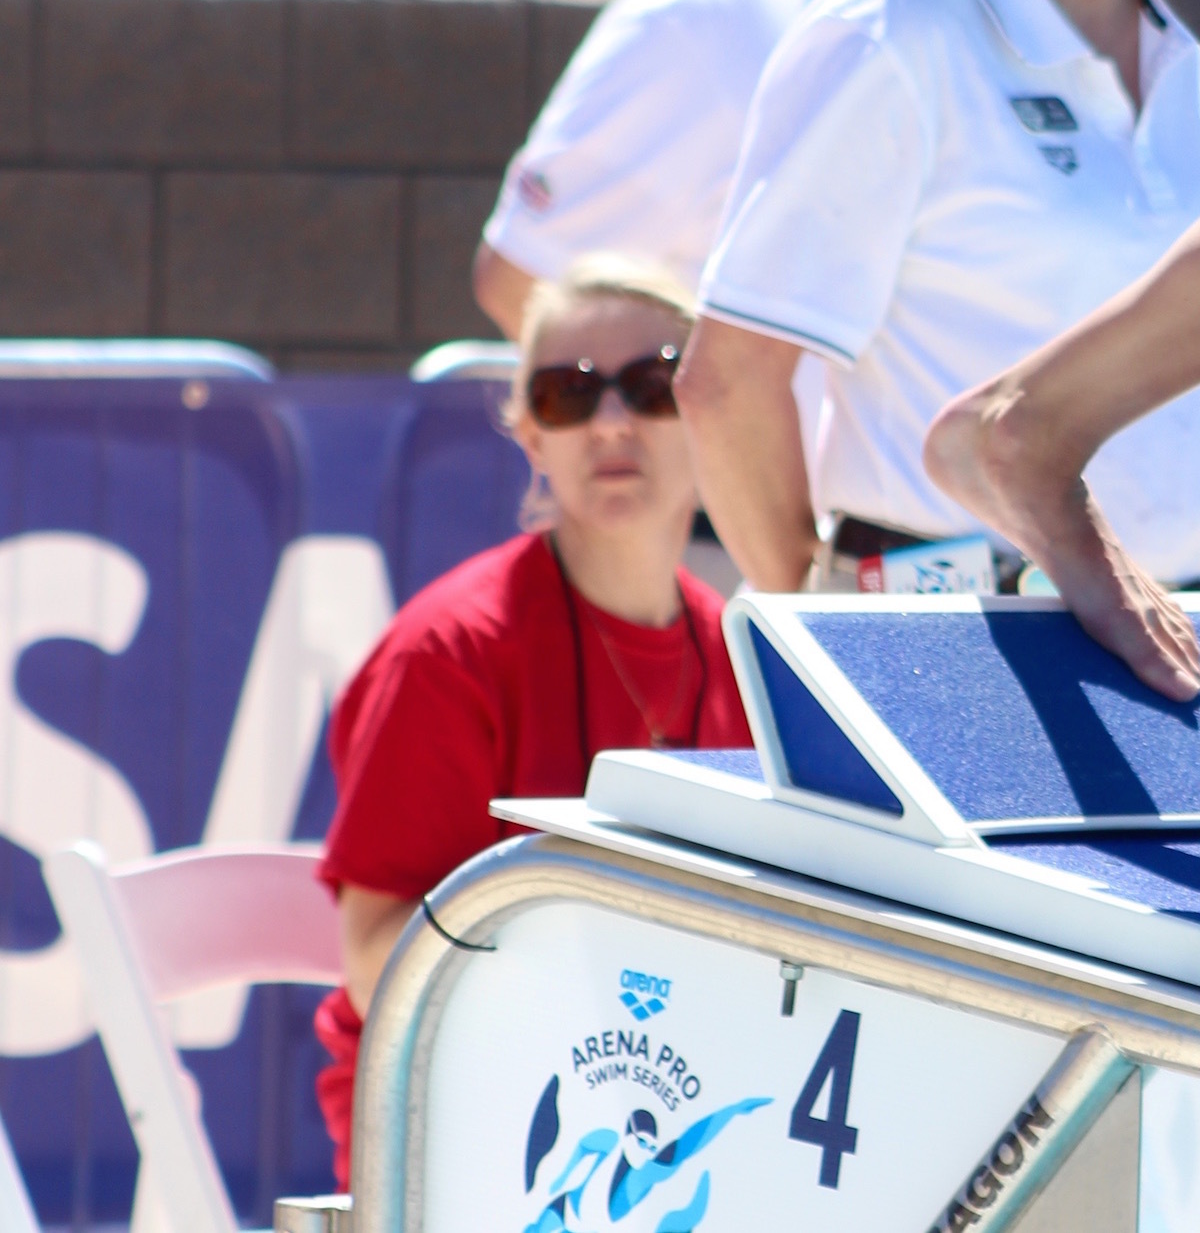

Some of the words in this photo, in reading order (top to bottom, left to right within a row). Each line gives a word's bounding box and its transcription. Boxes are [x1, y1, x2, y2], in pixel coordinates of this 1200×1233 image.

[620, 968, 672, 998] arena
[572, 1029, 650, 1073] ARENA
[655, 1043, 701, 1101] PRO
[585, 1063, 628, 1090] SWIM
[632, 1065, 682, 1112] SERIES
[787, 1008, 861, 1191] 4
[925, 1093, 1056, 1233] AGON
